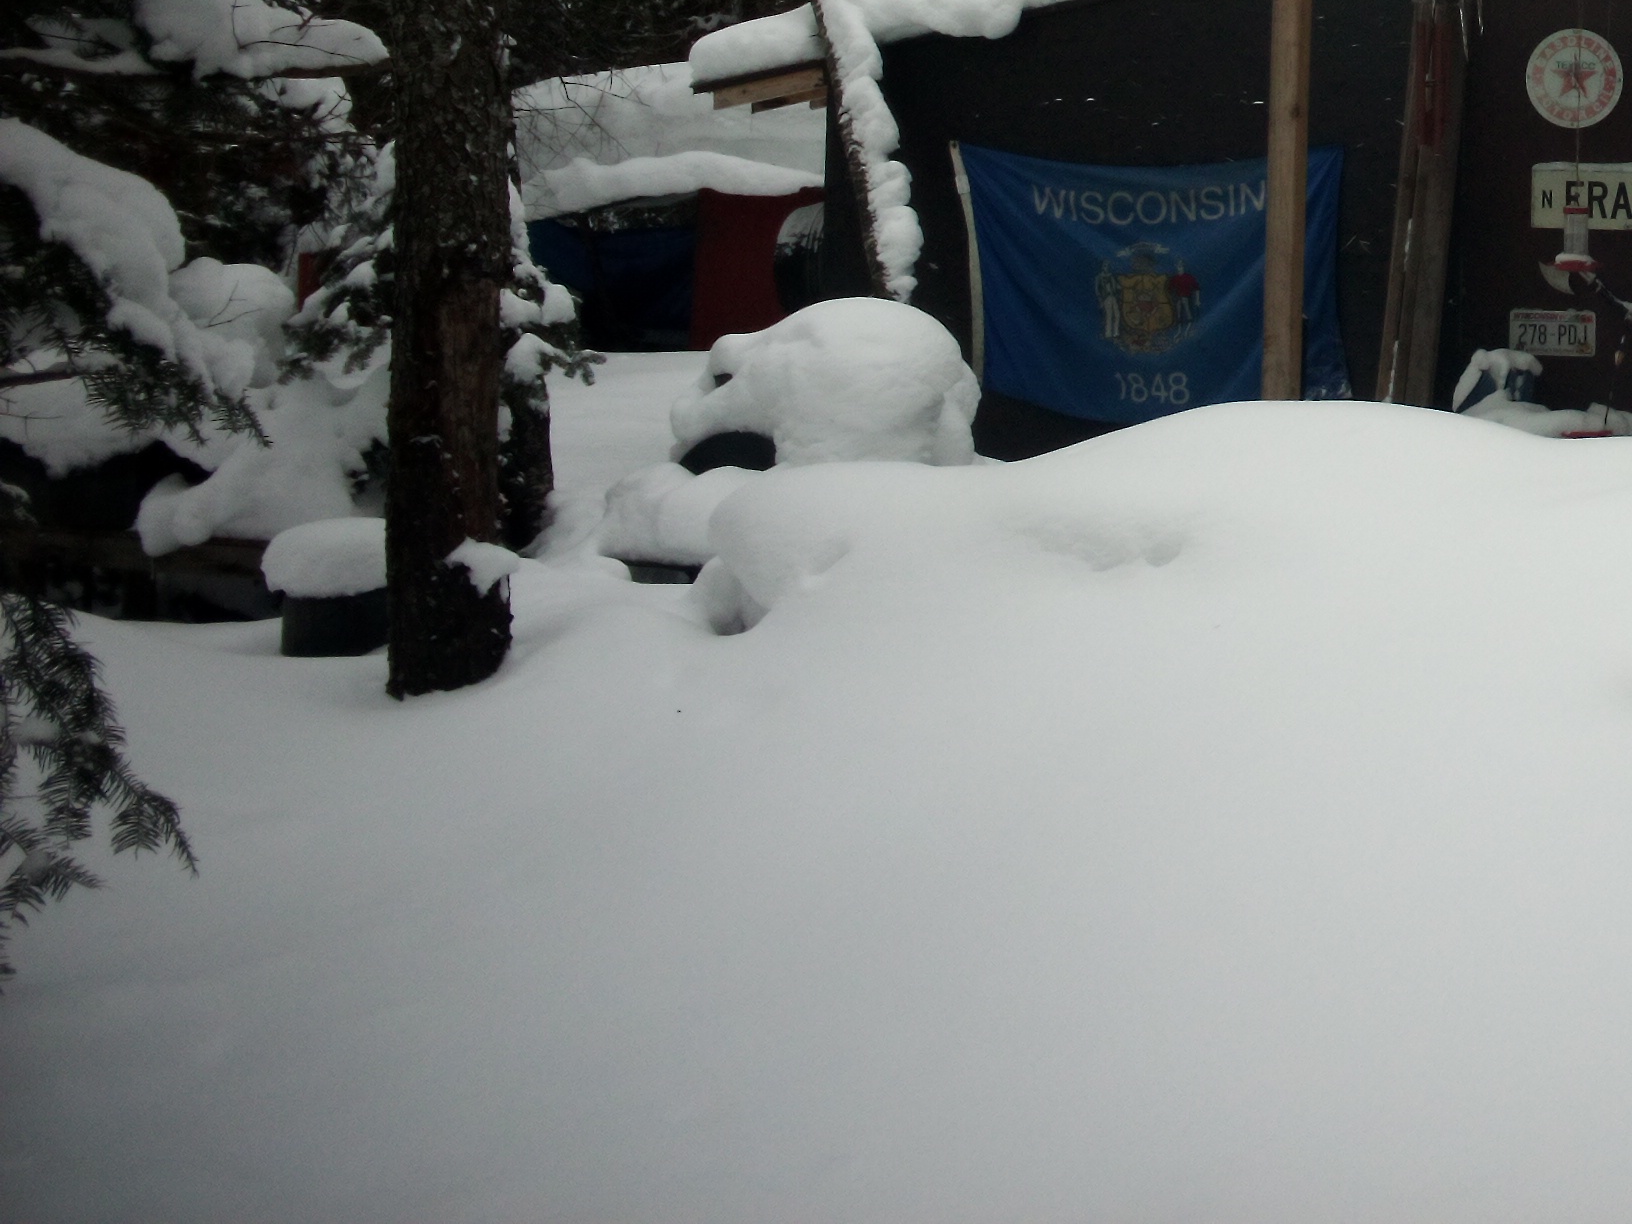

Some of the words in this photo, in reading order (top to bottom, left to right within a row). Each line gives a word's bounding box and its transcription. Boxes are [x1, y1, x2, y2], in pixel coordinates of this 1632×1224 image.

[1032, 180, 1265, 225] WISCONSIN
[1541, 189, 1553, 209] N
[1115, 372, 1190, 405] 1848
